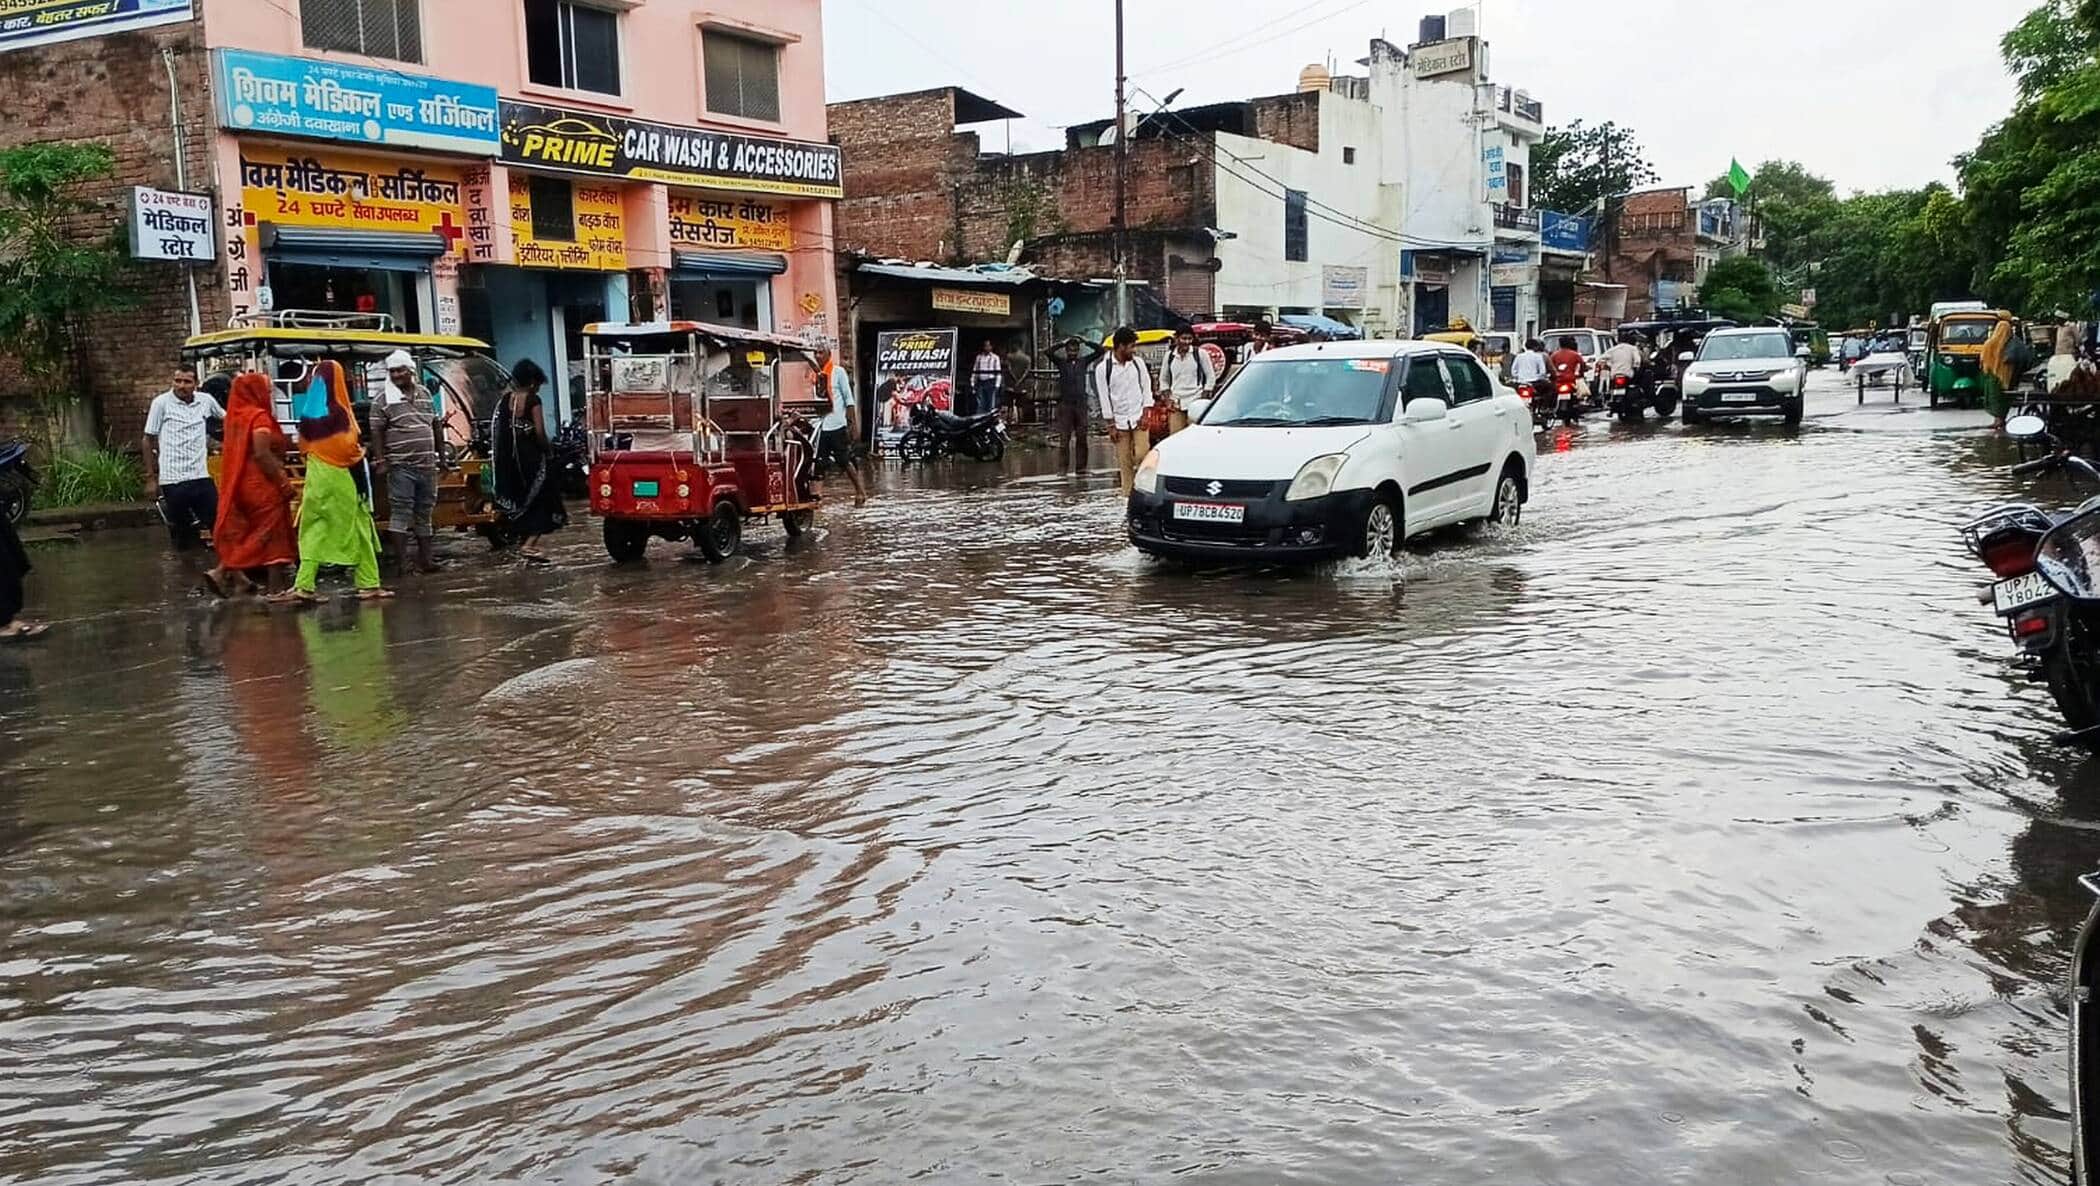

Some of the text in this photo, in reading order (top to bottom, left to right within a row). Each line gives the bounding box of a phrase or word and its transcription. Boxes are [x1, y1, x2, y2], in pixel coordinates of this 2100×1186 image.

[232, 67, 496, 133] शिवम मेडिकल एण्ड सर्जिकल
[521, 133, 617, 168] PRIME
[624, 128, 660, 163] CAR
[664, 134, 713, 169] WASH
[717, 142, 729, 170] &
[733, 143, 836, 181] ACCESSORIES
[285, 157, 368, 197] मेडिकल
[378, 168, 459, 204] सर्जिकल
[152, 194, 164, 204] 24
[143, 208, 207, 234] मेडिकल
[277, 199, 419, 222] 24 घण्टे सेवा उपलब्ध
[160, 235, 194, 256] स्टोर
[880, 348, 951, 361] CAR WASH
[899, 340, 936, 350] PRIME
[2005, 573, 2039, 594] UP71
